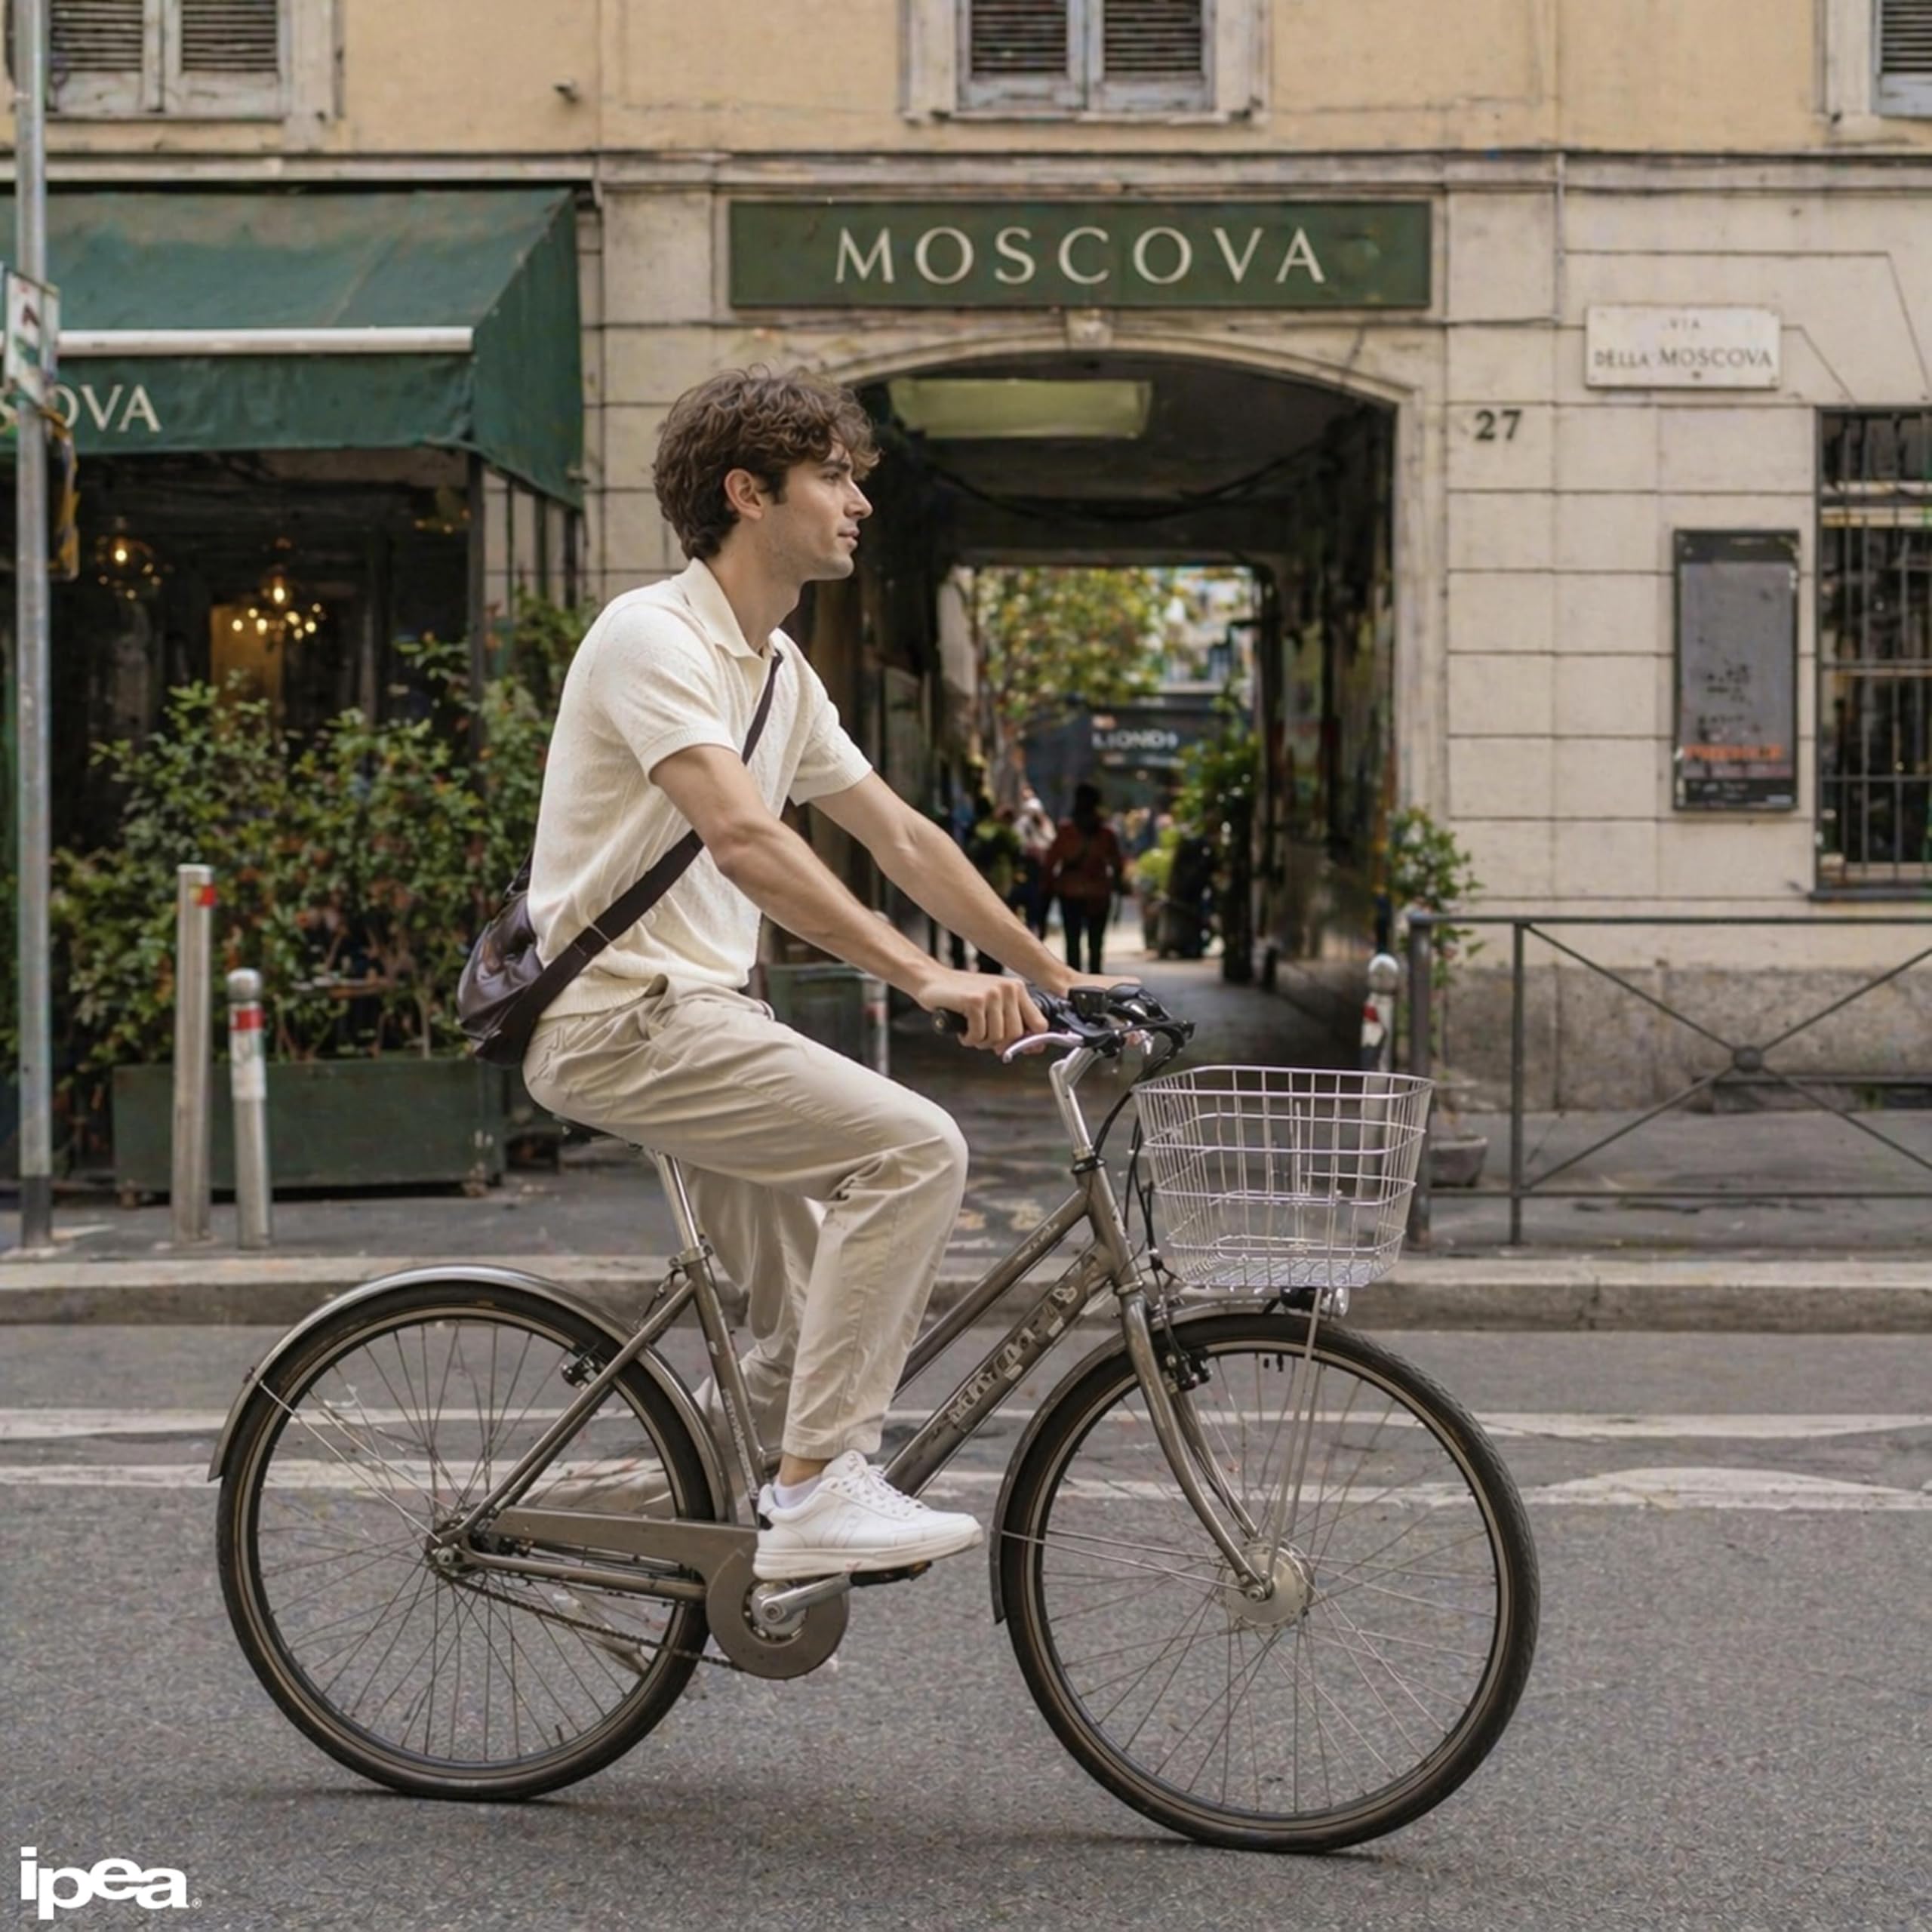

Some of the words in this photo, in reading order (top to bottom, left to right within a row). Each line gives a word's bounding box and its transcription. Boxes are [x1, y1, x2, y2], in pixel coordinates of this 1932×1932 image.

[835, 226, 1325, 285] MOSCOVA
[1669, 317, 1700, 330] VIA
[1594, 350, 1649, 368] DELLA
[1660, 347, 1773, 368] MOSCOVA
[1475, 409, 1521, 441] 27
